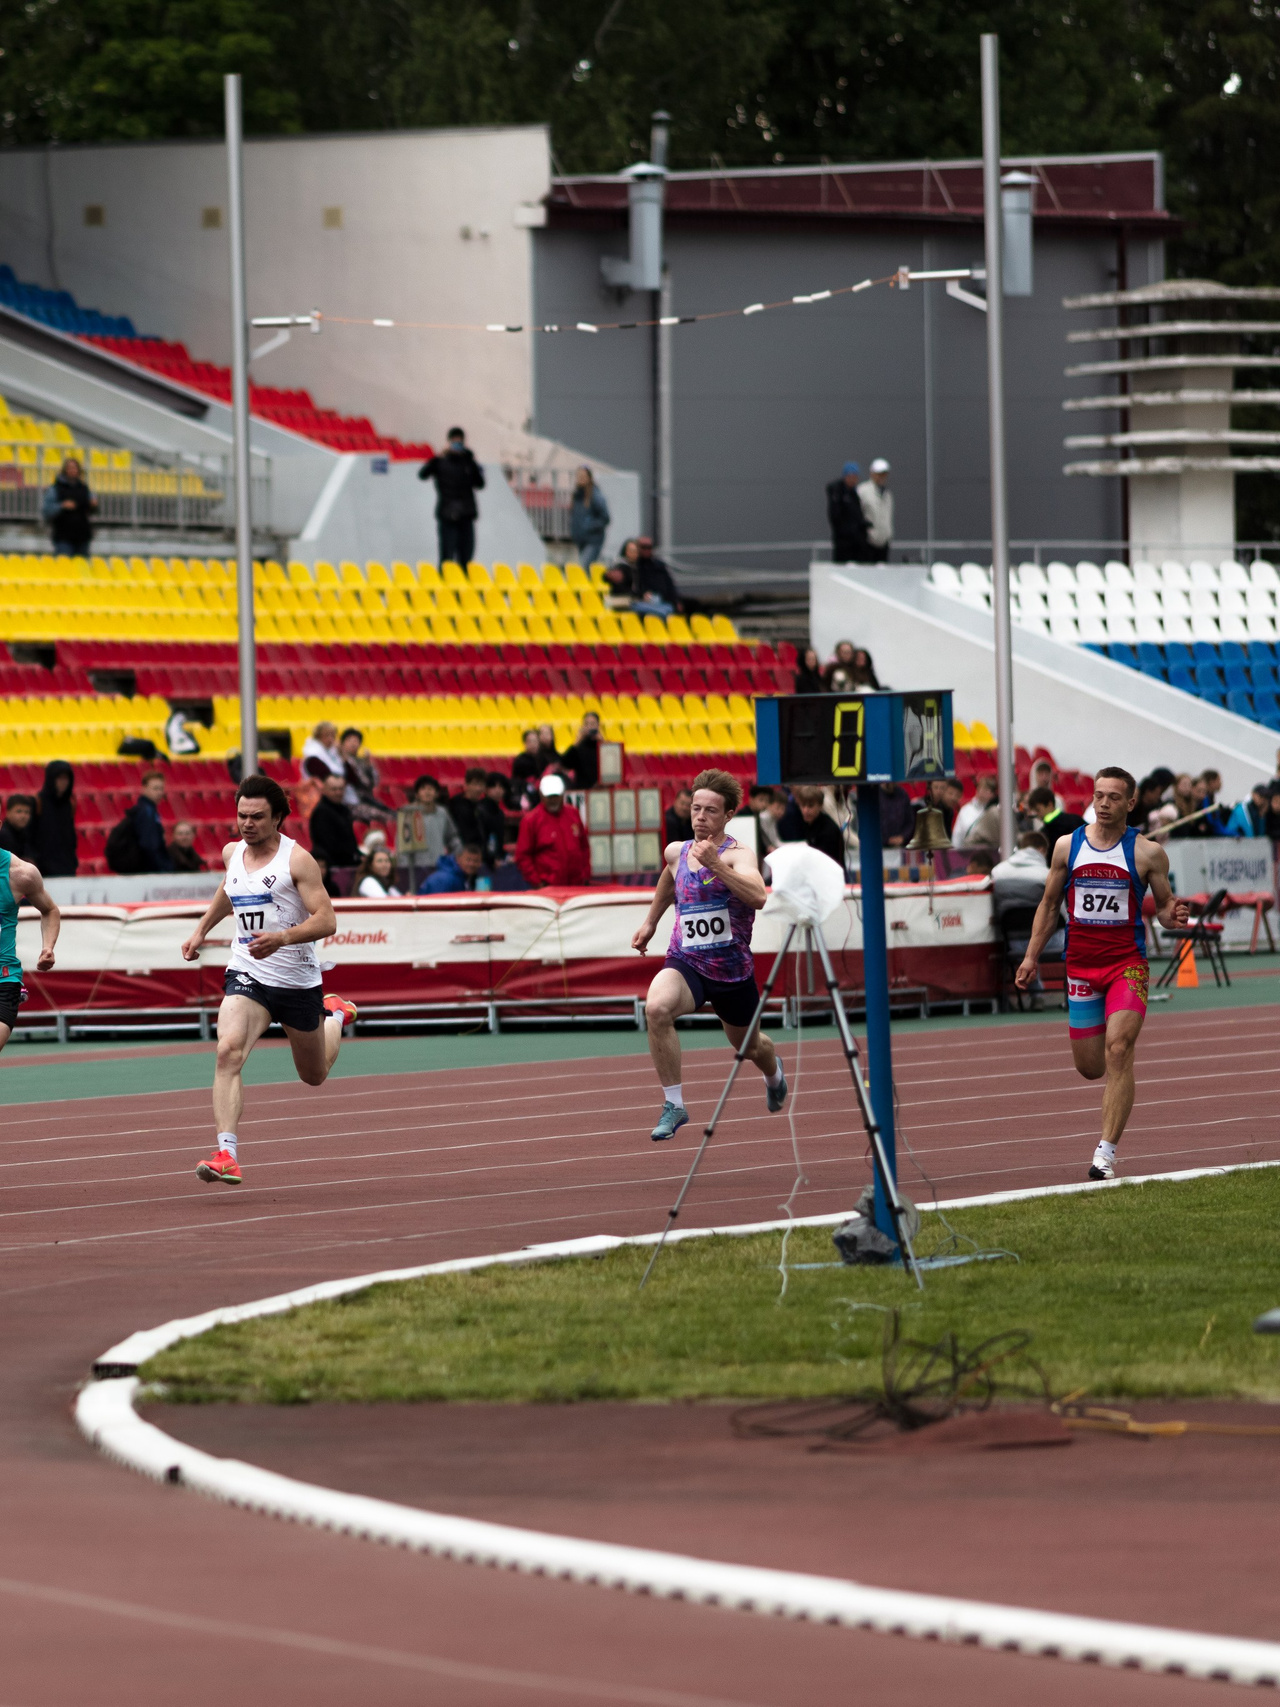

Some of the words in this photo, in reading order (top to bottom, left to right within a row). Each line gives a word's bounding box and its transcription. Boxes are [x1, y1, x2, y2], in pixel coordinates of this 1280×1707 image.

[830, 701, 864, 777] 0
[1082, 869, 1119, 879] RUSSIA
[1082, 893, 1120, 913] 874
[238, 911, 264, 930] 177
[684, 916, 725, 938] 300
[322, 928, 388, 948] polanik
